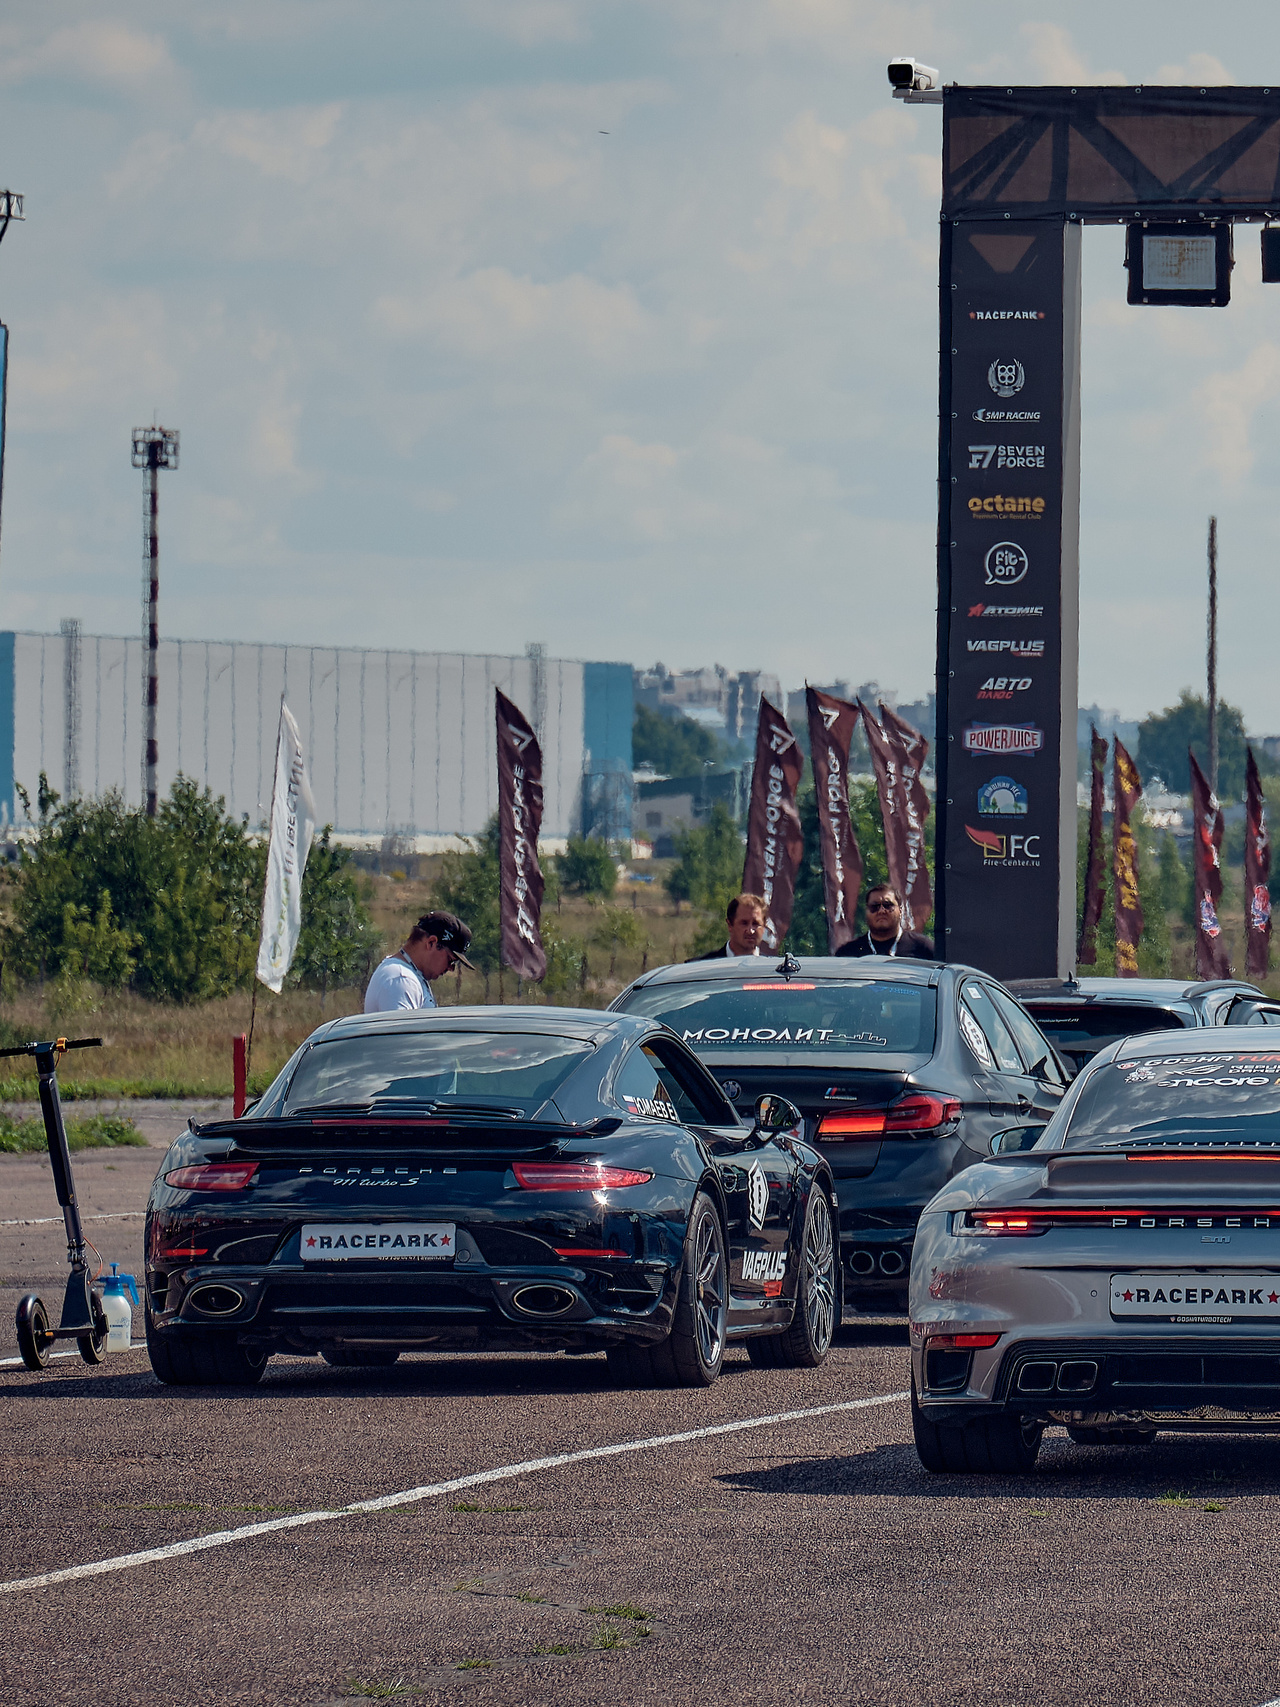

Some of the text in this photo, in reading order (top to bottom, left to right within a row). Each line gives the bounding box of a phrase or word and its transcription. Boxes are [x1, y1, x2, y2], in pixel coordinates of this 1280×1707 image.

[977, 311, 1038, 320] RACEPARK
[985, 411, 1041, 420] SMP RACING
[997, 445, 1045, 456] SEVEN
[997, 456, 1045, 468] FORCE
[968, 495, 1045, 513] octane
[995, 565, 1015, 576] on
[981, 606, 1043, 616] ATOMIC
[967, 640, 1045, 652] VAGPLUS
[980, 677, 1032, 691] АВТО
[969, 729, 1039, 749] POWERJUICE
[1010, 835, 1041, 858] FC
[984, 859, 1041, 867] Fire-Center.ru
[683, 1027, 833, 1041] МОНОЛИТ
[1144, 1055, 1234, 1067] GOSHA
[1158, 1077, 1270, 1088] encore
[333, 1177, 419, 1186] 911 turbo S
[319, 1233, 438, 1249] RACEPARK
[741, 1251, 788, 1280] VAGPLUS
[1136, 1288, 1264, 1304] RACEPARK
